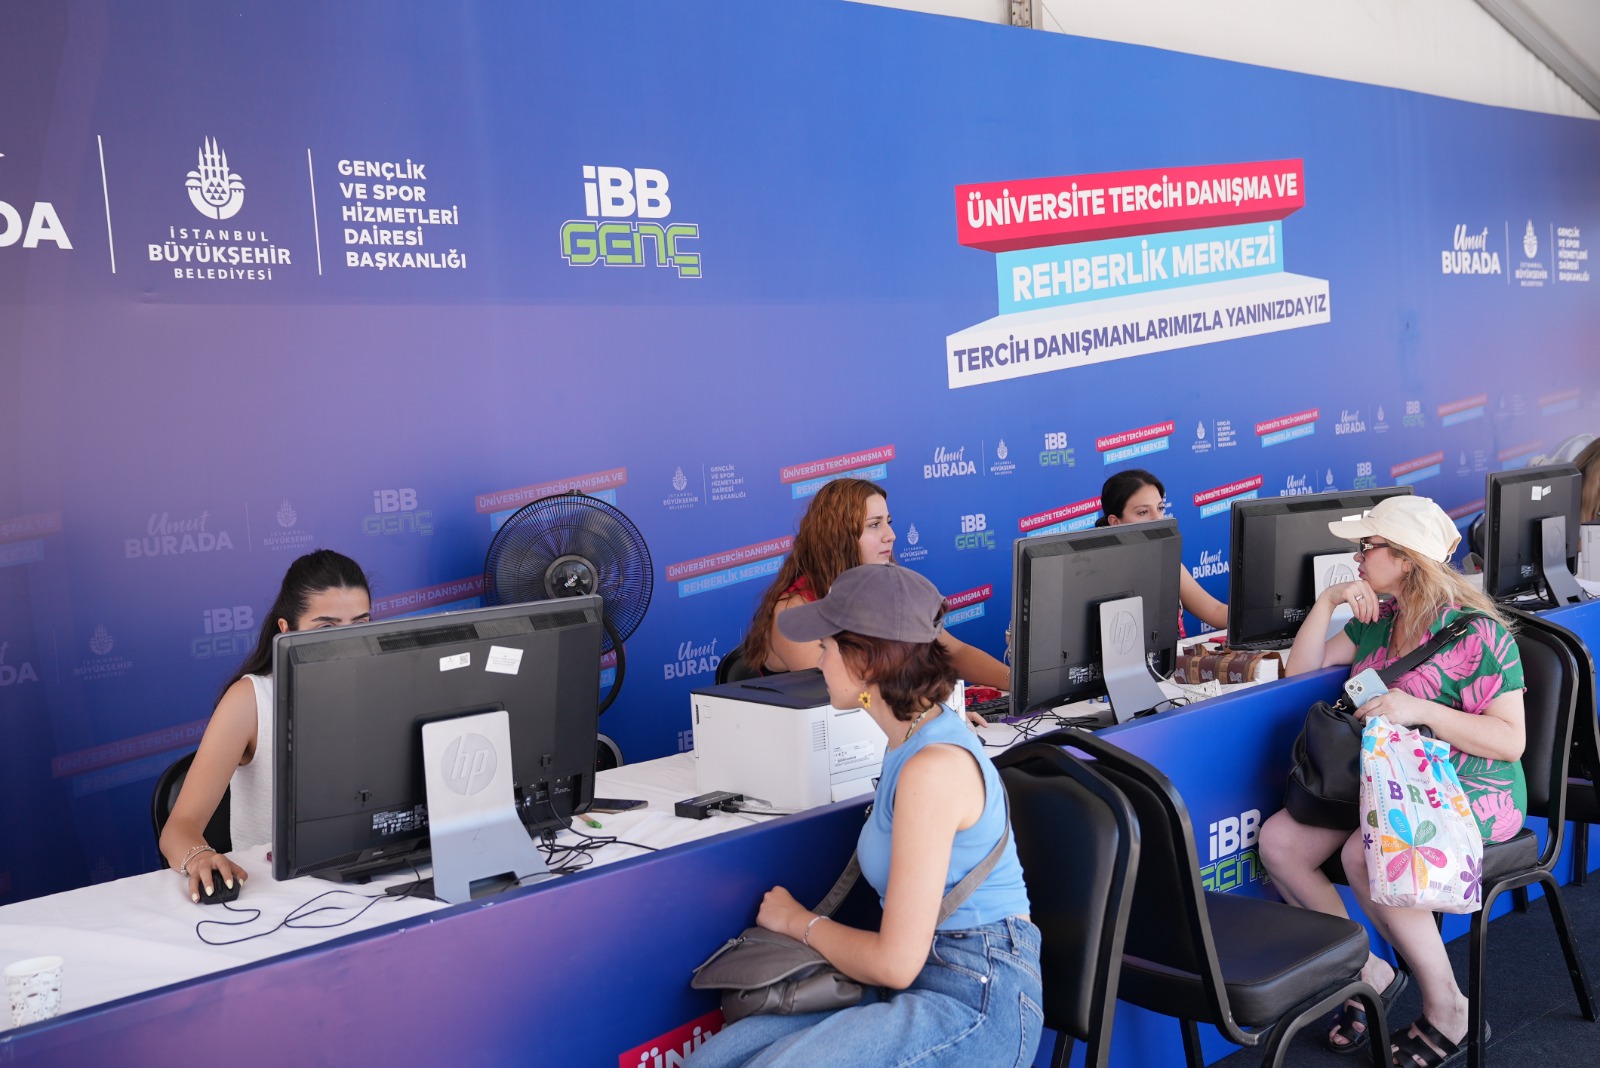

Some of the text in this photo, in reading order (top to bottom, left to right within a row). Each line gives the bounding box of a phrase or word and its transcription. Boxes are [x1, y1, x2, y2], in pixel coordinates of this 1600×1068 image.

[338, 159, 427, 182] GENÇLİK
[340, 183, 426, 202] VE SPOR
[967, 172, 1298, 229] ÜNİVERSİTE TERCİH DANIŞMA VE
[342, 201, 459, 225] HİZMETLERİ
[169, 226, 269, 242] İSTANBUL
[344, 224, 423, 246] DAİRESİ
[1453, 223, 1489, 252] Umut
[148, 243, 292, 266] BÜYÜKŞEHİR
[346, 247, 467, 271] BAŞKANLIĞI
[1012, 224, 1276, 302] REHBERLİK MERKEZİ
[1441, 250, 1502, 275] BURADA
[173, 267, 273, 281] BELEDİYESİ
[953, 292, 1327, 373] TERCİH DANIŞMANLARIMIZLA YANINIZDAYIZ
[1335, 421, 1366, 435] BURADA
[783, 462, 825, 479] ÜNİVERSİTE
[825, 456, 851, 470] TERCİH
[882, 448, 892, 457] VE
[934, 446, 965, 464] Umut
[923, 460, 977, 479] BURADA
[479, 489, 535, 508] ÜNİVERSİTE
[535, 481, 569, 498] TERCİH
[612, 472, 624, 482] VE
[146, 510, 210, 536] Umut
[124, 531, 234, 559] BURADA
[1200, 549, 1222, 565] Umut
[668, 539, 791, 577] ÜNİVERSİTE TERCİH DANIŞMA VE
[1192, 560, 1230, 579] BURADA
[683, 556, 784, 594] REHBERLİK MERKEZİ
[390, 592, 427, 610] TERCİH
[427, 581, 474, 600] DANIŞMA
[981, 587, 990, 596] VE
[948, 605, 982, 624] MERKEZİ
[677, 637, 719, 661] Umut
[663, 655, 722, 680] BURAD
[448, 735, 490, 796] hp
